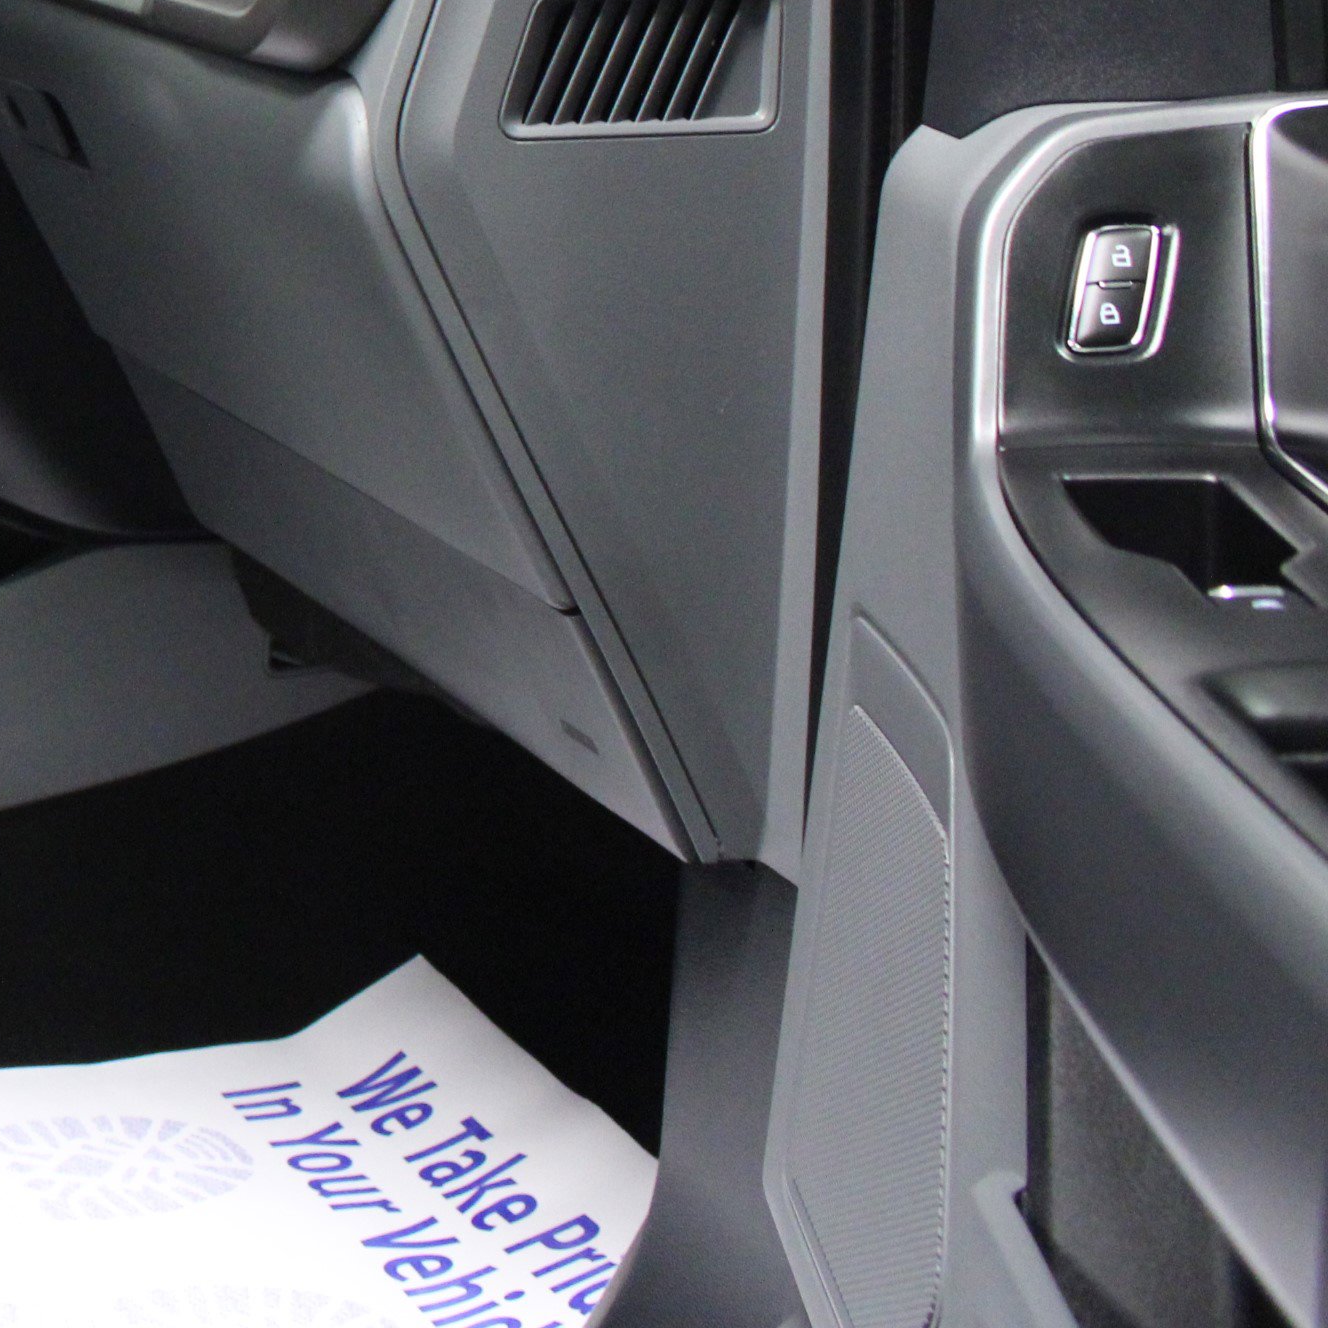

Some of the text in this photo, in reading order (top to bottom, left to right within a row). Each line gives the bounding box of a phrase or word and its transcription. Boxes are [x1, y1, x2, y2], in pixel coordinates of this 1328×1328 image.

[221, 1081, 562, 1328] In Your Vehi
[336, 1051, 437, 1136] We
[403, 1116, 538, 1231] Take
